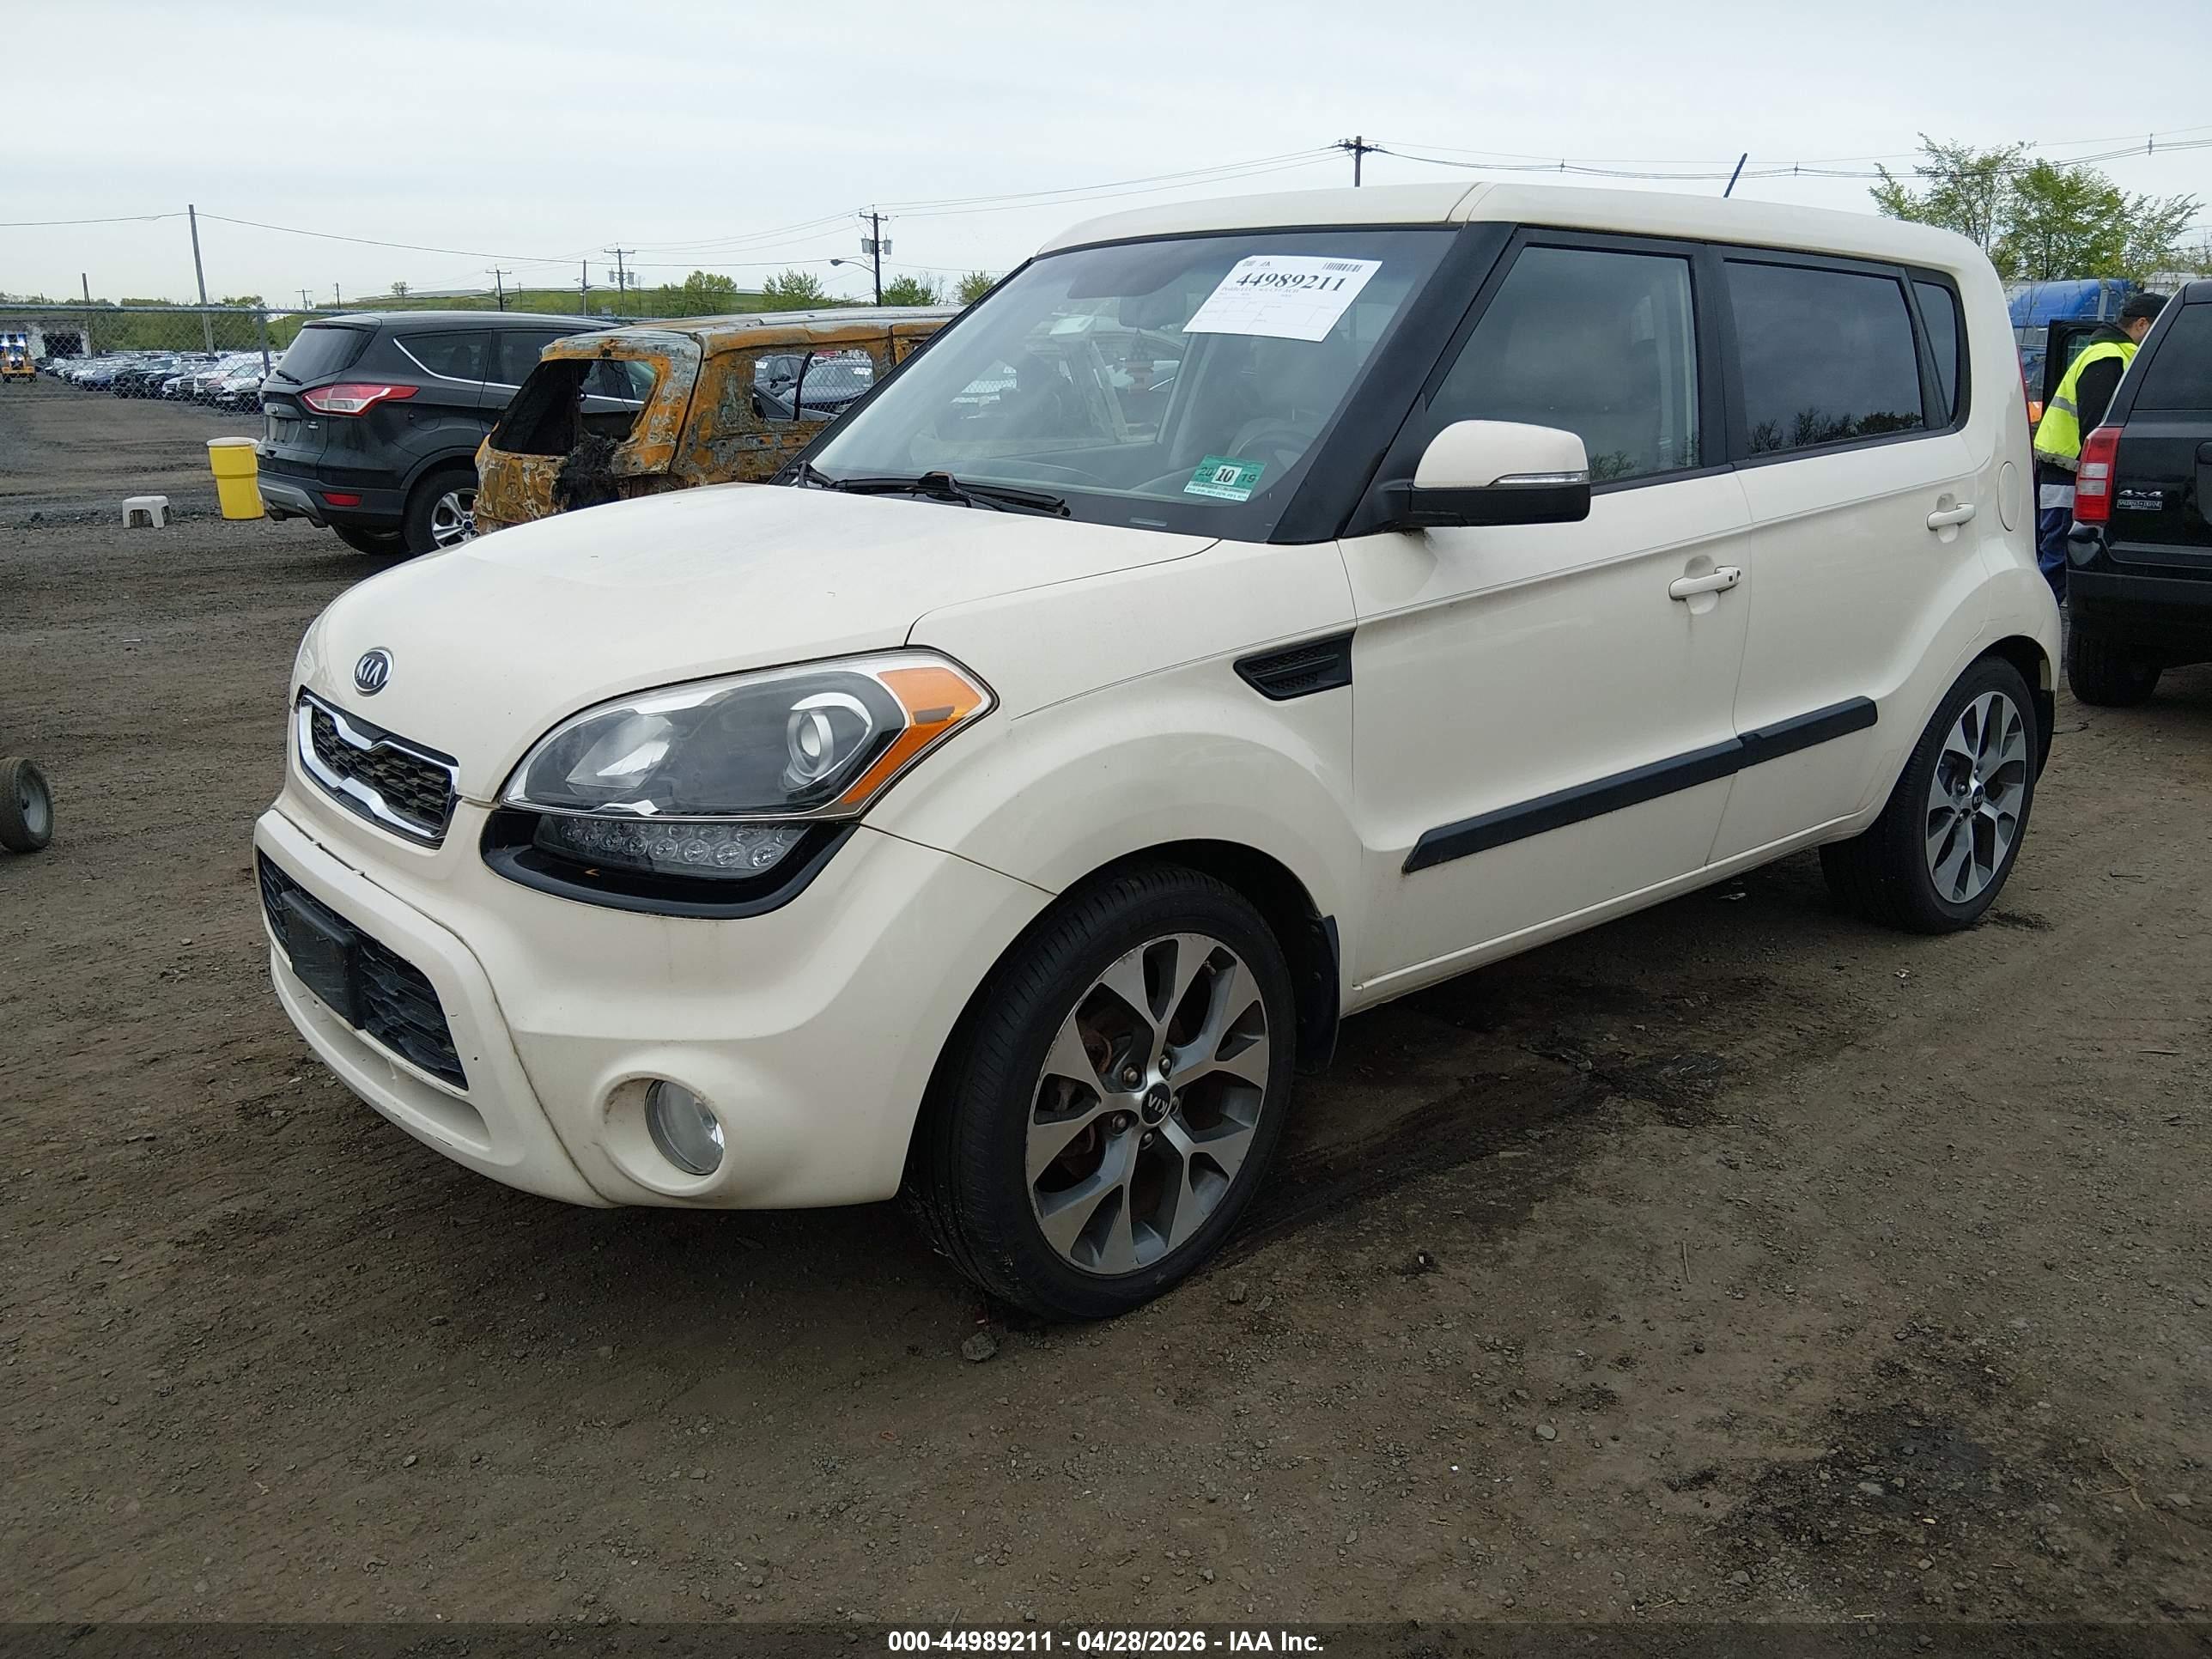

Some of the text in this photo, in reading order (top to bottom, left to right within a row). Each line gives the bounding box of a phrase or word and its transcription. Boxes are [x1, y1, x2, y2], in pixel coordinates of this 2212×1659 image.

[1236, 272, 1346, 291] 44989211
[1215, 468, 1235, 483] 10
[2118, 489, 2163, 498] 4x4
[356, 656, 384, 686] KIA
[1148, 1092, 1168, 1115] KIA
